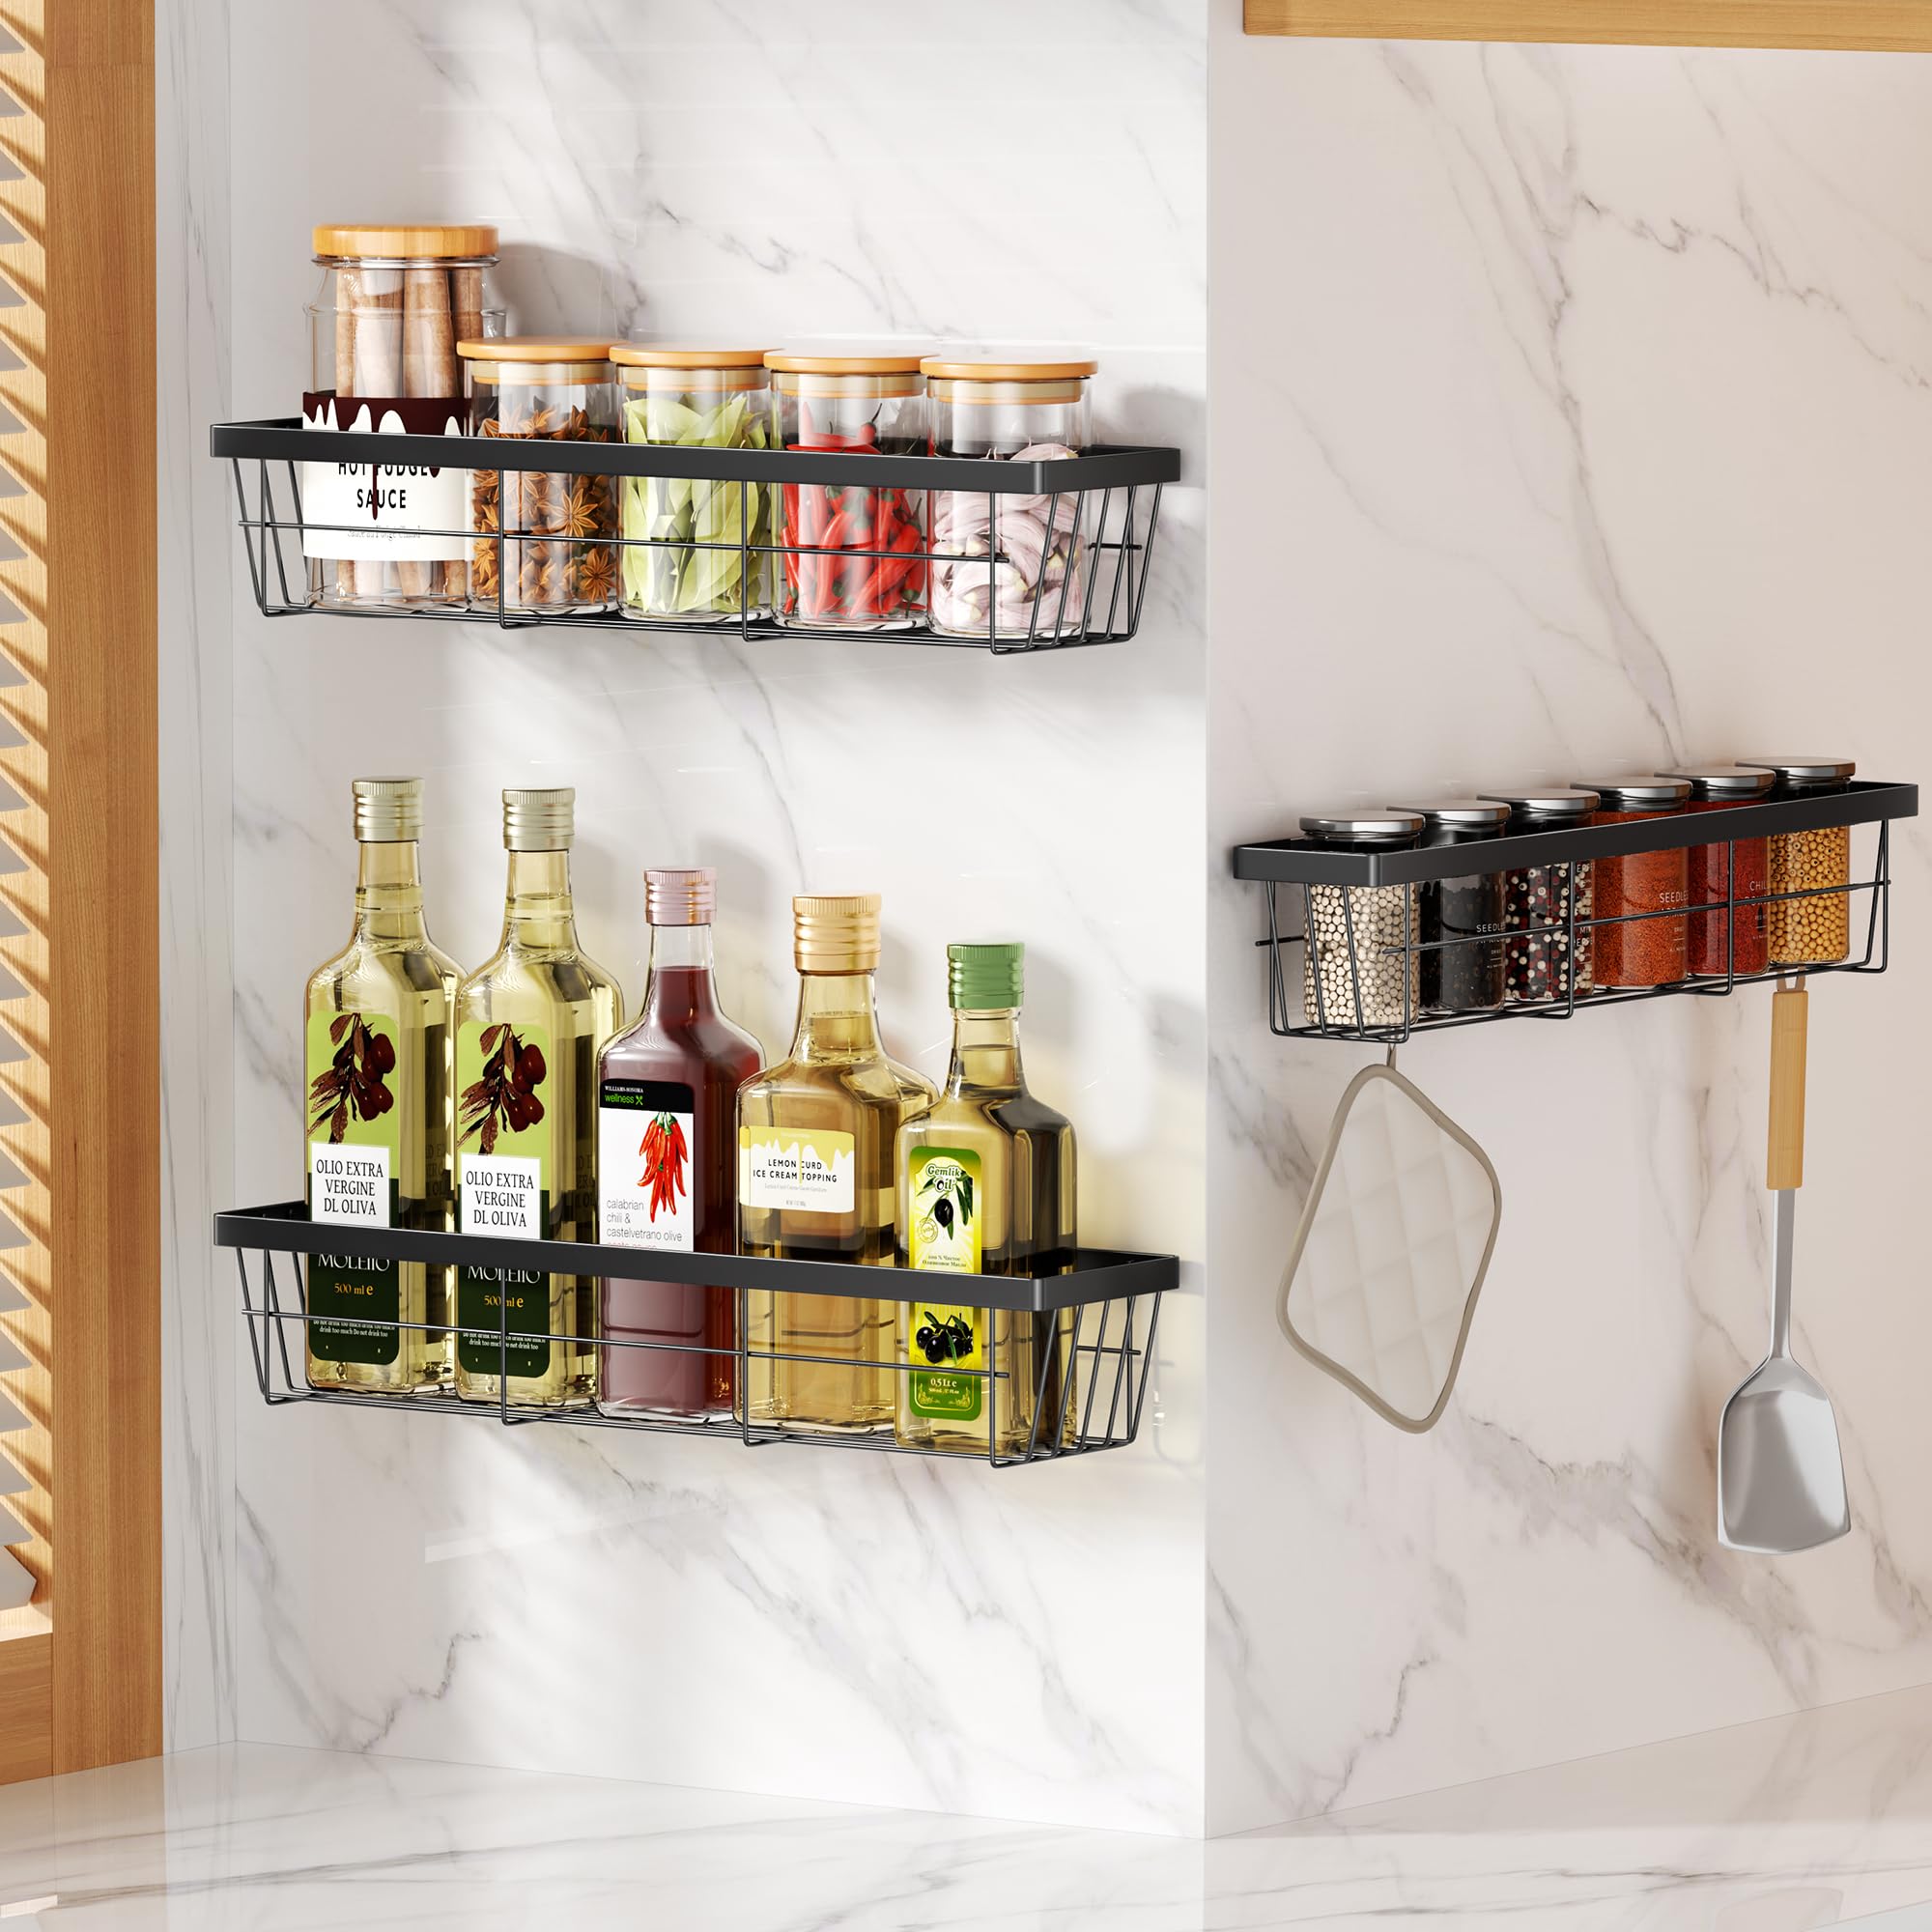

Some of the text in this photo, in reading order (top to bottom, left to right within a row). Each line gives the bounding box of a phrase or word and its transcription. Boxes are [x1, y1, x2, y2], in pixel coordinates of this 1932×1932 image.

[357, 488, 406, 509] SAUCE
[604, 1093, 635, 1104] wellness
[316, 1158, 384, 1178] OLIO EXTRA
[768, 1159, 822, 1170] LEMON CURD
[927, 1165, 961, 1177] Gemlik
[466, 1170, 534, 1190] OLIO EXTRA
[753, 1169, 838, 1183] ICE CREAM TOPPING
[325, 1179, 376, 1196] VERGINE
[936, 1179, 952, 1191] Oil
[475, 1190, 526, 1208] VERGINE
[607, 1199, 644, 1210] calabrian
[324, 1197, 377, 1216] DL OLIVA
[473, 1209, 527, 1227] DL OLIVA
[607, 1212, 630, 1224] chili &
[607, 1228, 682, 1242] castelvetrano olive
[334, 1282, 374, 1295] 500 ml e
[484, 1295, 501, 1306] 500
[516, 1297, 524, 1308] e
